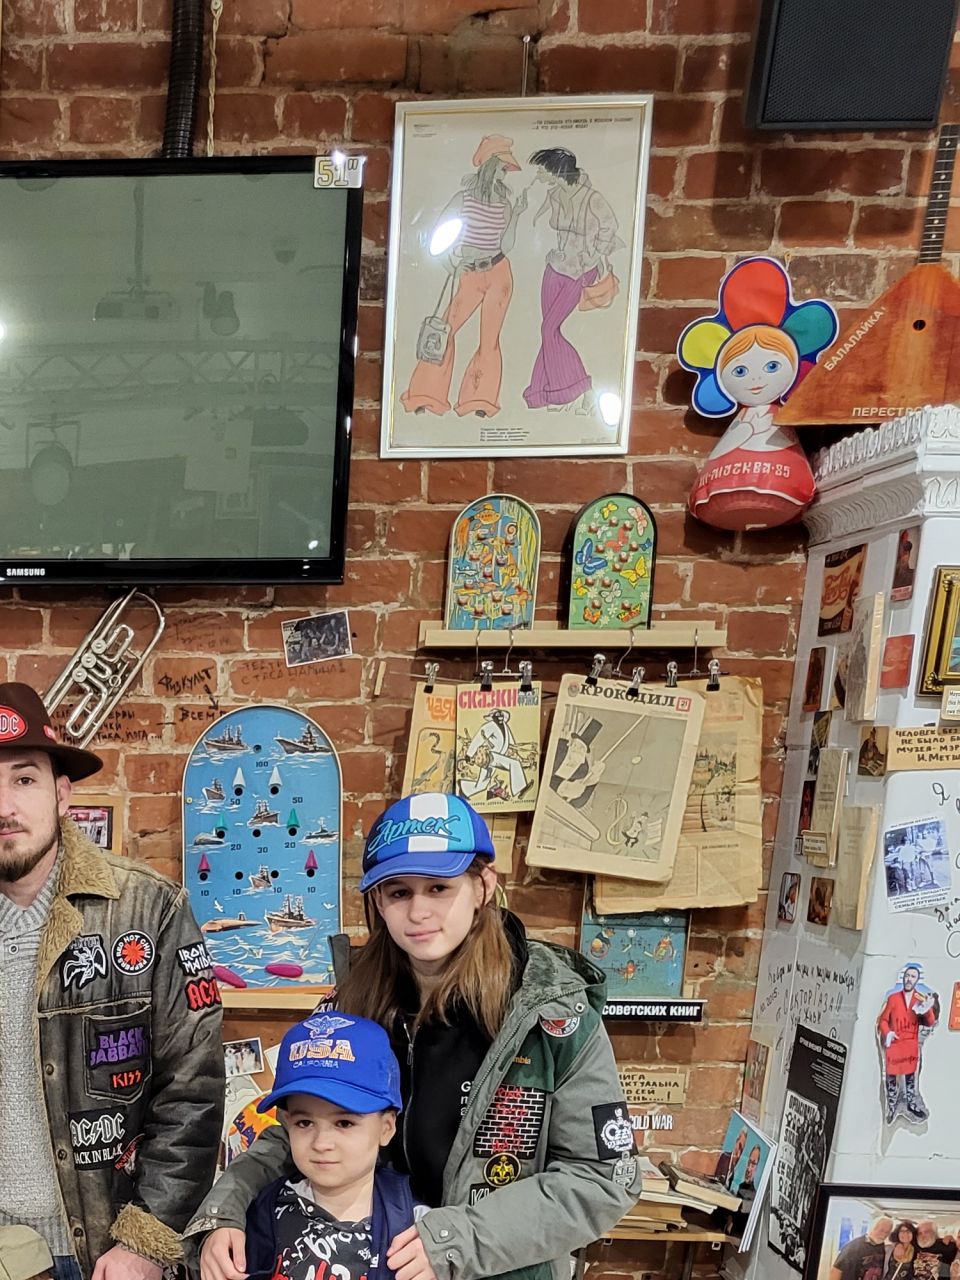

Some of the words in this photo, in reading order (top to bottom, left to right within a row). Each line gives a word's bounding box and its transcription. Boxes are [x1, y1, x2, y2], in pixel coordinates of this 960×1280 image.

[852, 407, 922, 417] ПЕРЕСТР
[6, 568, 45, 577] SAMSUNG
[459, 688, 517, 709] СКАЗКИ
[255, 760, 269, 769] 100
[230, 797, 241, 806] 50
[292, 796, 303, 805] 50
[230, 843, 242, 852] 20
[257, 845, 269, 855] 30
[284, 841, 296, 850] 20
[200, 889, 210, 898] 10
[232, 888, 242, 896] 10
[272, 886, 283, 895] 10
[307, 886, 317, 895] 10
[123, 934, 141, 944] HOT
[178, 944, 205, 962] IRON
[181, 954, 212, 975] MAID
[99, 1026, 144, 1049] BLACK
[289, 1039, 356, 1062] USA
[112, 1070, 142, 1088] KISS
[651, 1114, 674, 1131] WAR
[92, 1149, 102, 1163] IN
